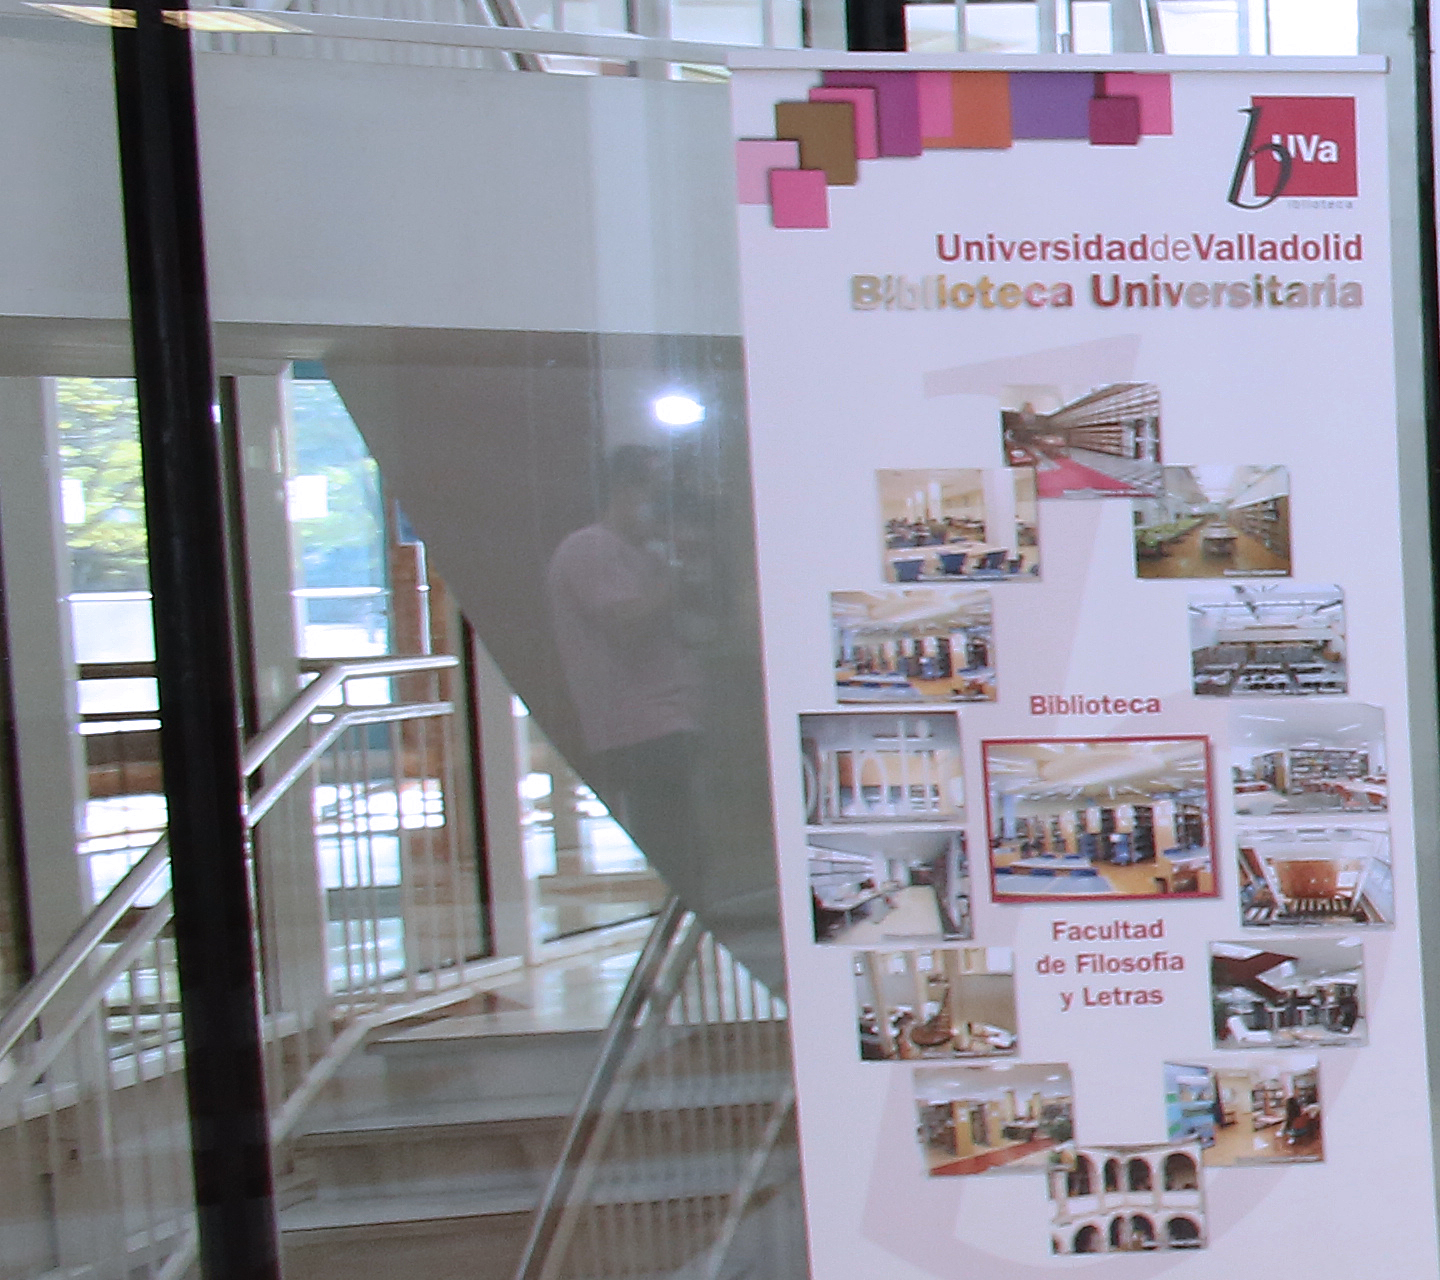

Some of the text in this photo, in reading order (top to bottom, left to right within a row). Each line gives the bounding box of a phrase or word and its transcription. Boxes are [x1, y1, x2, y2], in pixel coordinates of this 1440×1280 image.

[853, 274, 1364, 310] Biblioteca Universitaria
[1029, 693, 1162, 716] Biblioteca
[1052, 918, 1165, 941] Facultad
[1036, 954, 1066, 974] de
[1060, 986, 1164, 1012] y Letras
